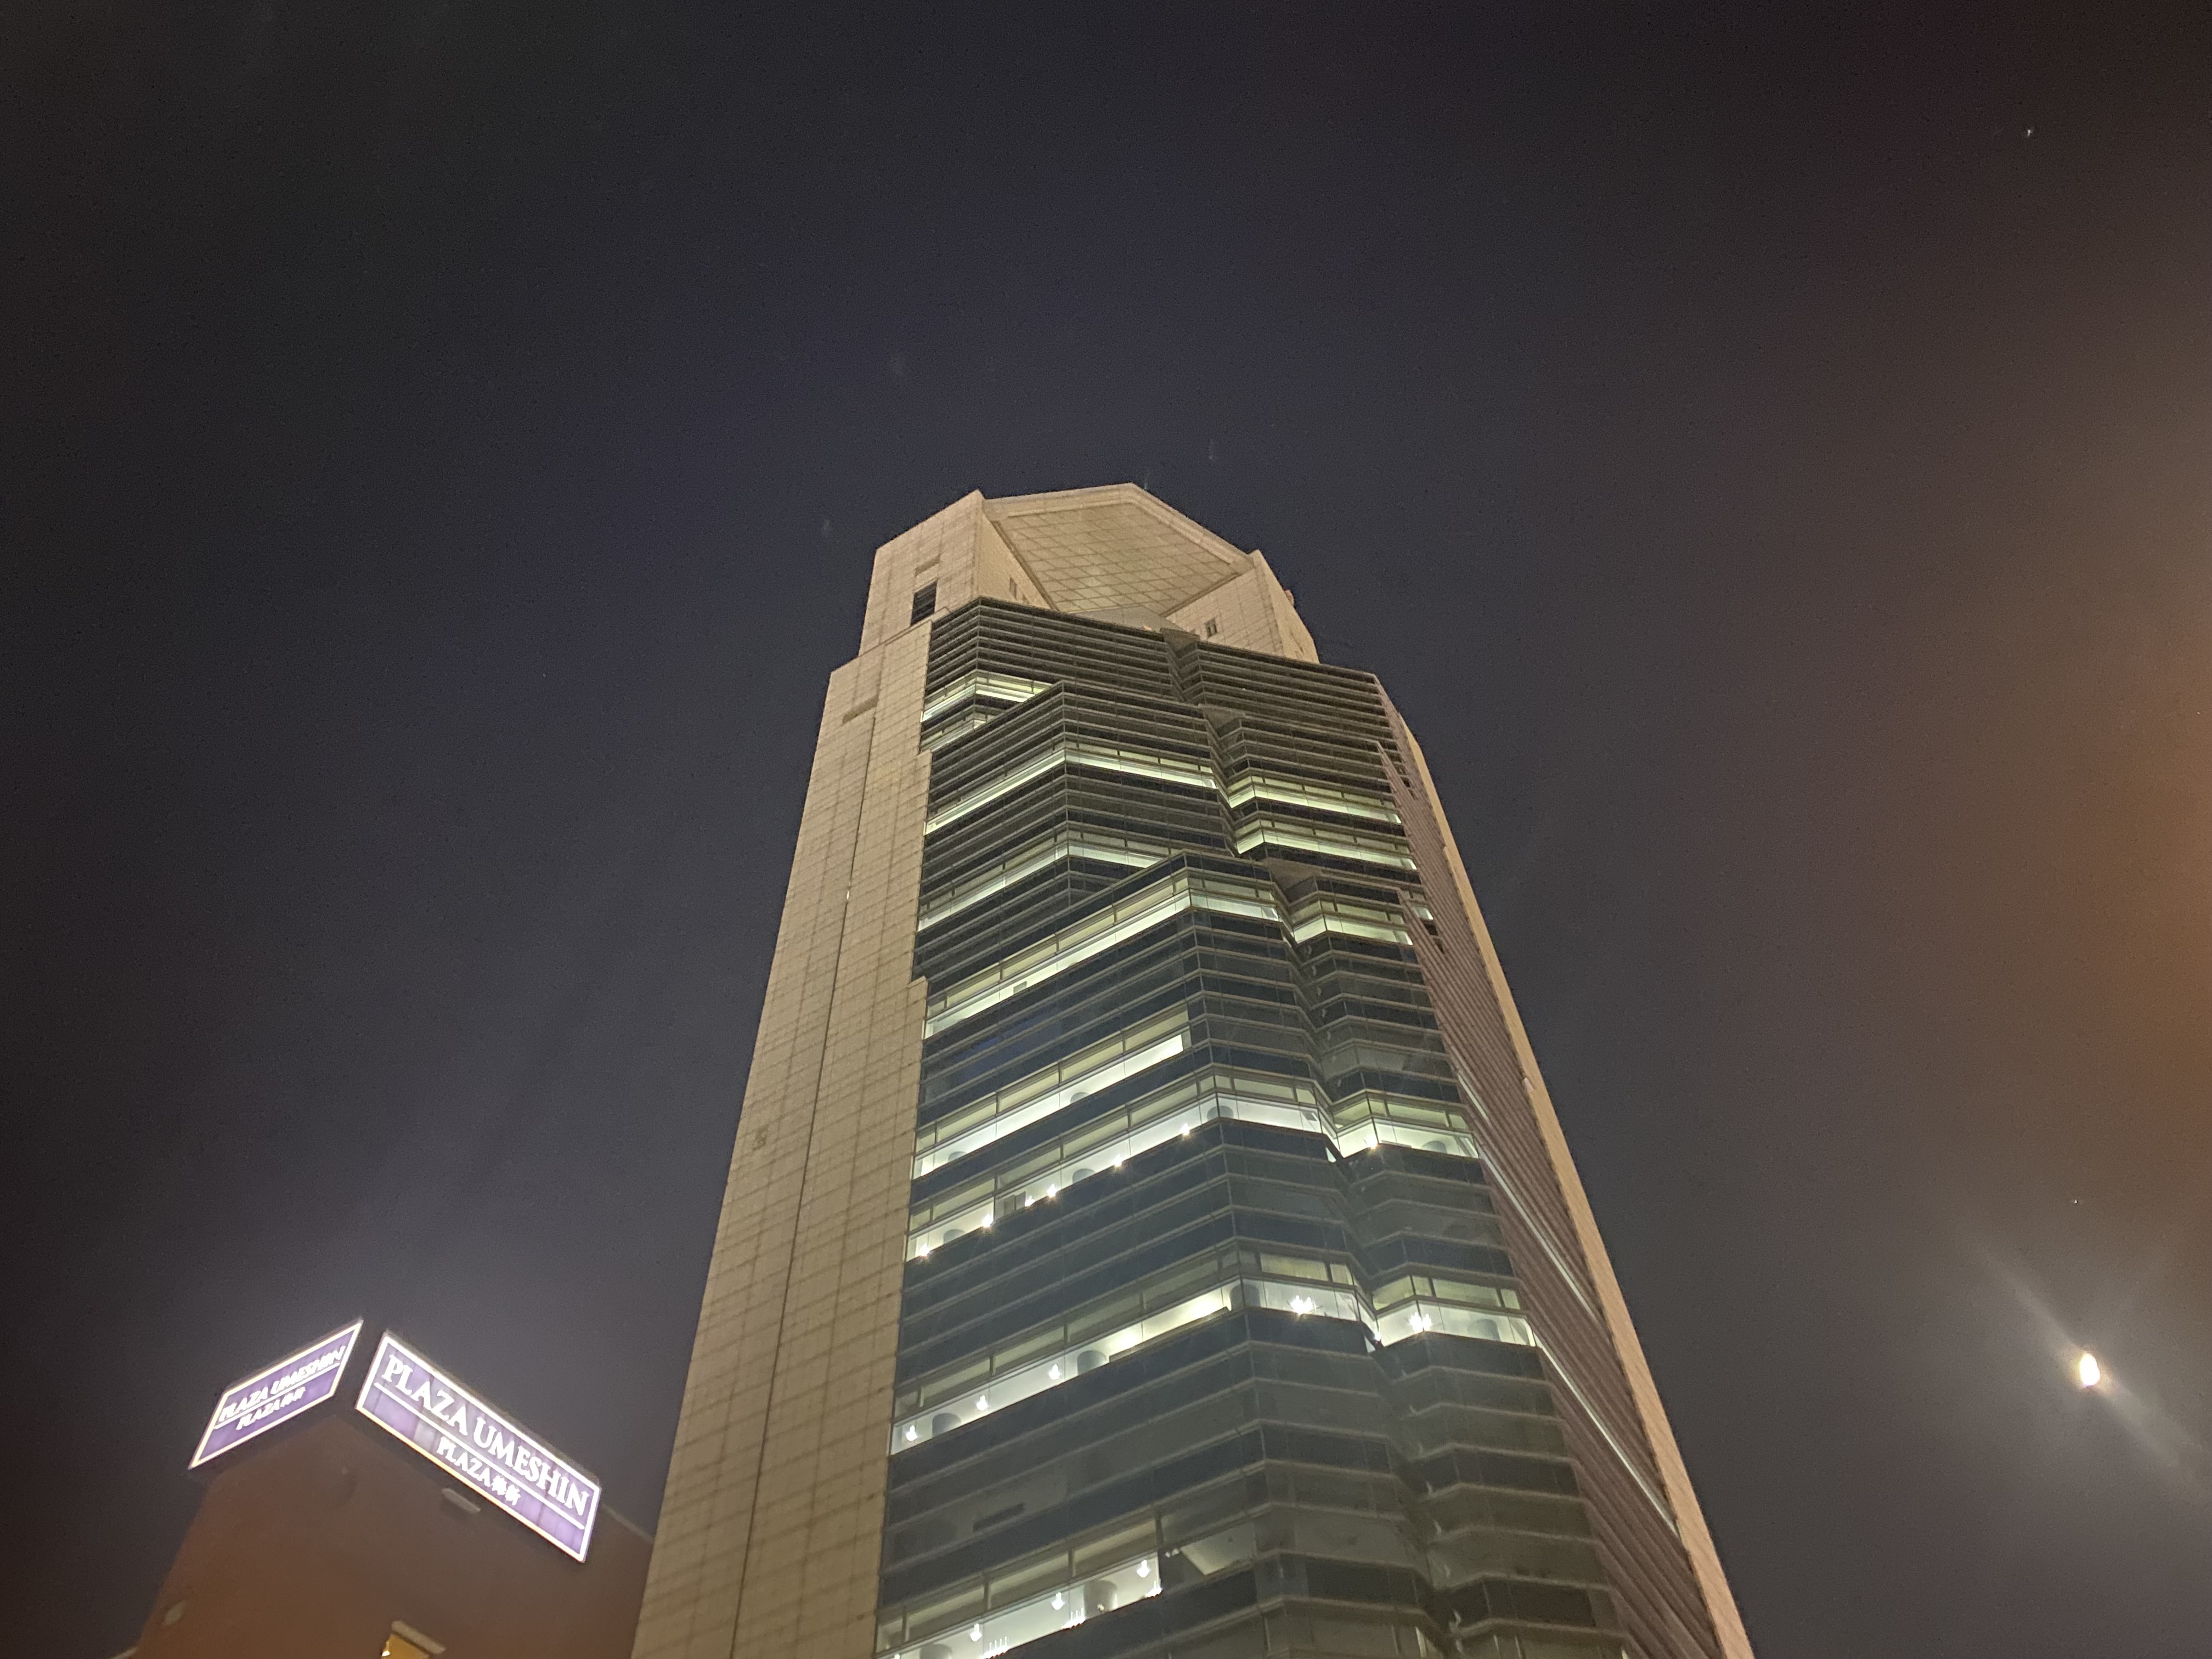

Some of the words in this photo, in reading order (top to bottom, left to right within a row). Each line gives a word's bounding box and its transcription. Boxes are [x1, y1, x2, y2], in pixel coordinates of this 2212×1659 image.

[219, 1386, 268, 1421] PLAZA
[236, 1400, 280, 1430] PLAZA
[381, 1355, 468, 1436] PLAZA
[473, 1417, 589, 1516] UMESHIN
[437, 1437, 492, 1487] PLAZA
